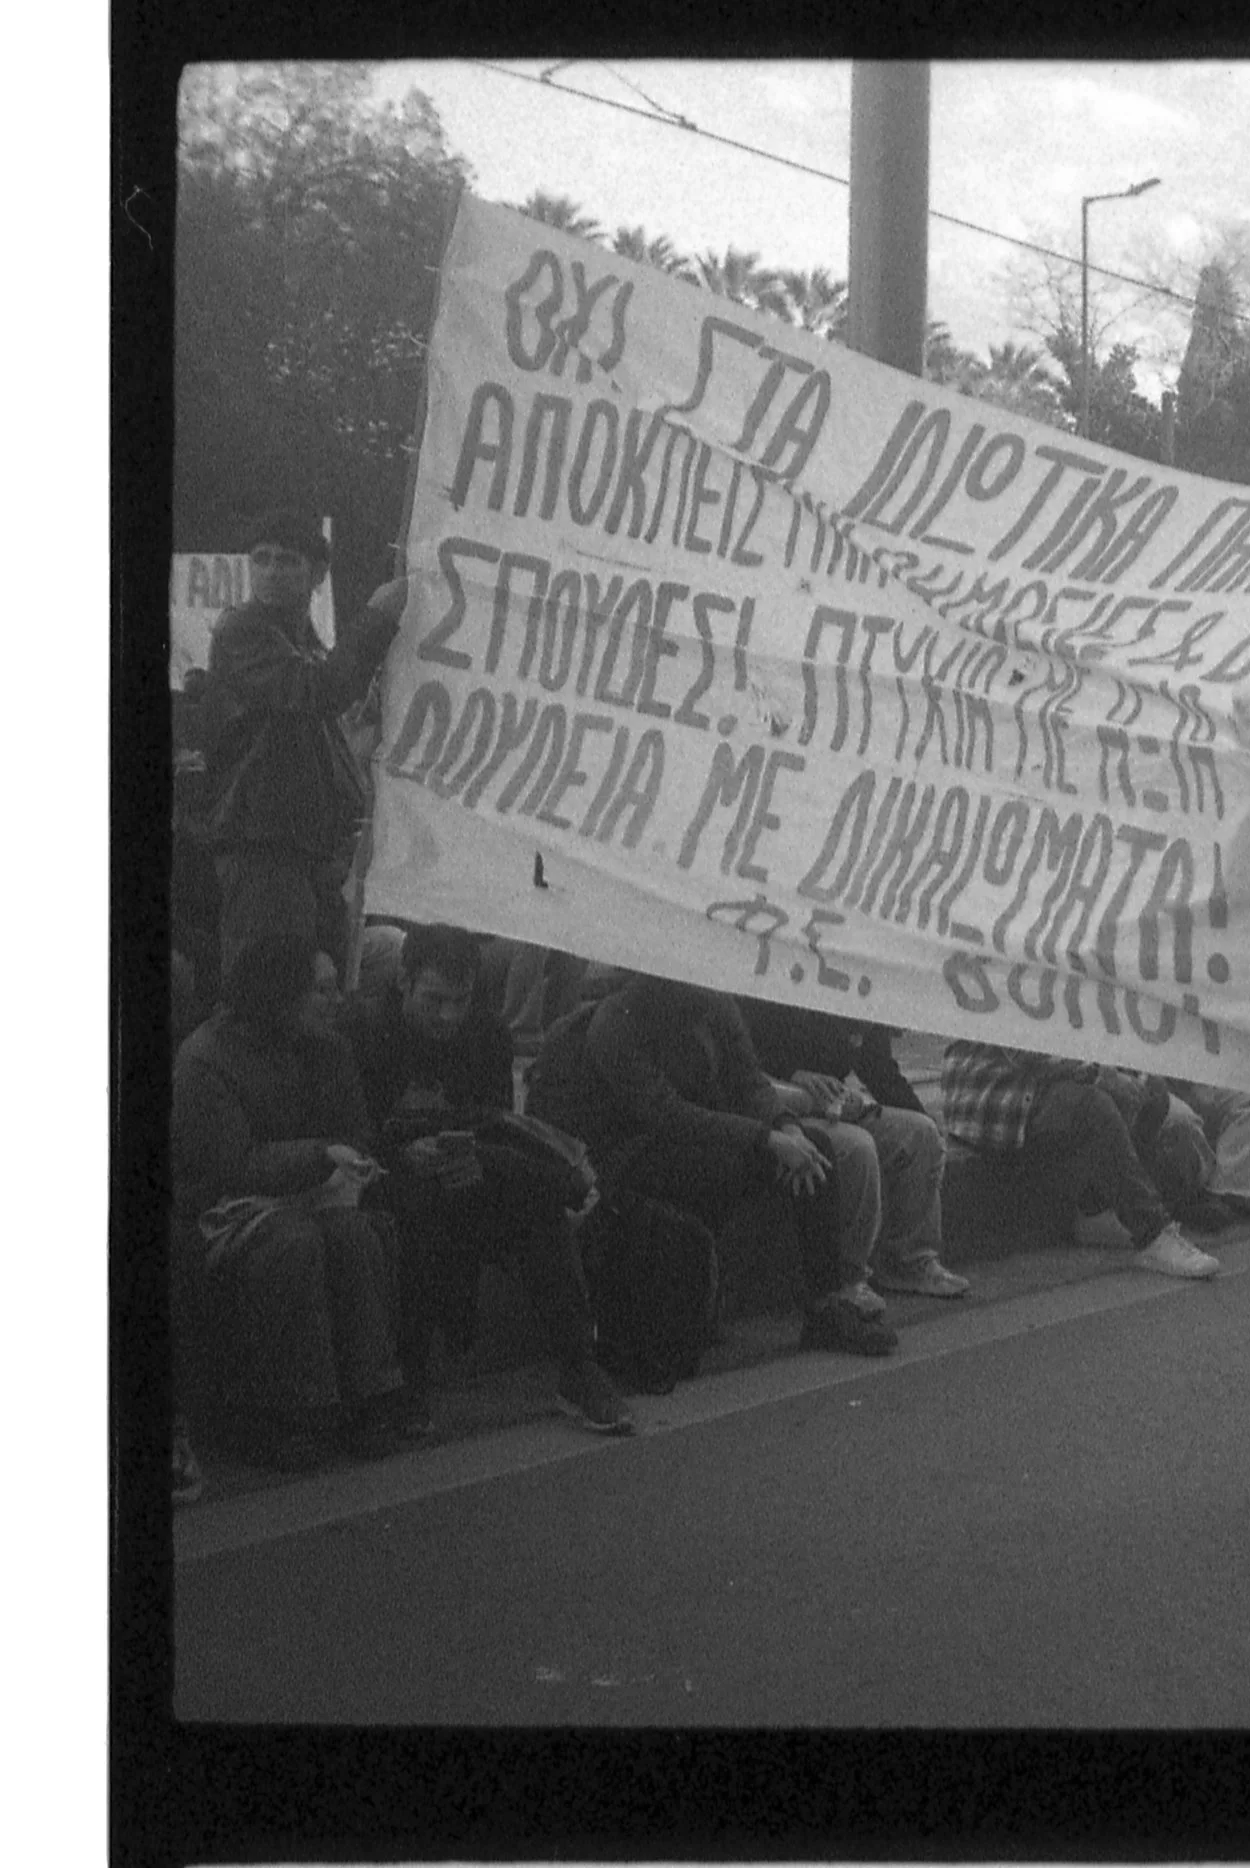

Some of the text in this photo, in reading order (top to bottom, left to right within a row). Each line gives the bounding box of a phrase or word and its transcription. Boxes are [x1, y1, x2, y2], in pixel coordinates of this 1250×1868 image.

[505, 250, 634, 391] ΟΧΙ
[663, 316, 830, 483] ΣΤΑ
[388, 681, 664, 848] ΔΟΥΛΕΙΑ
[678, 742, 804, 881] ΜΕ
